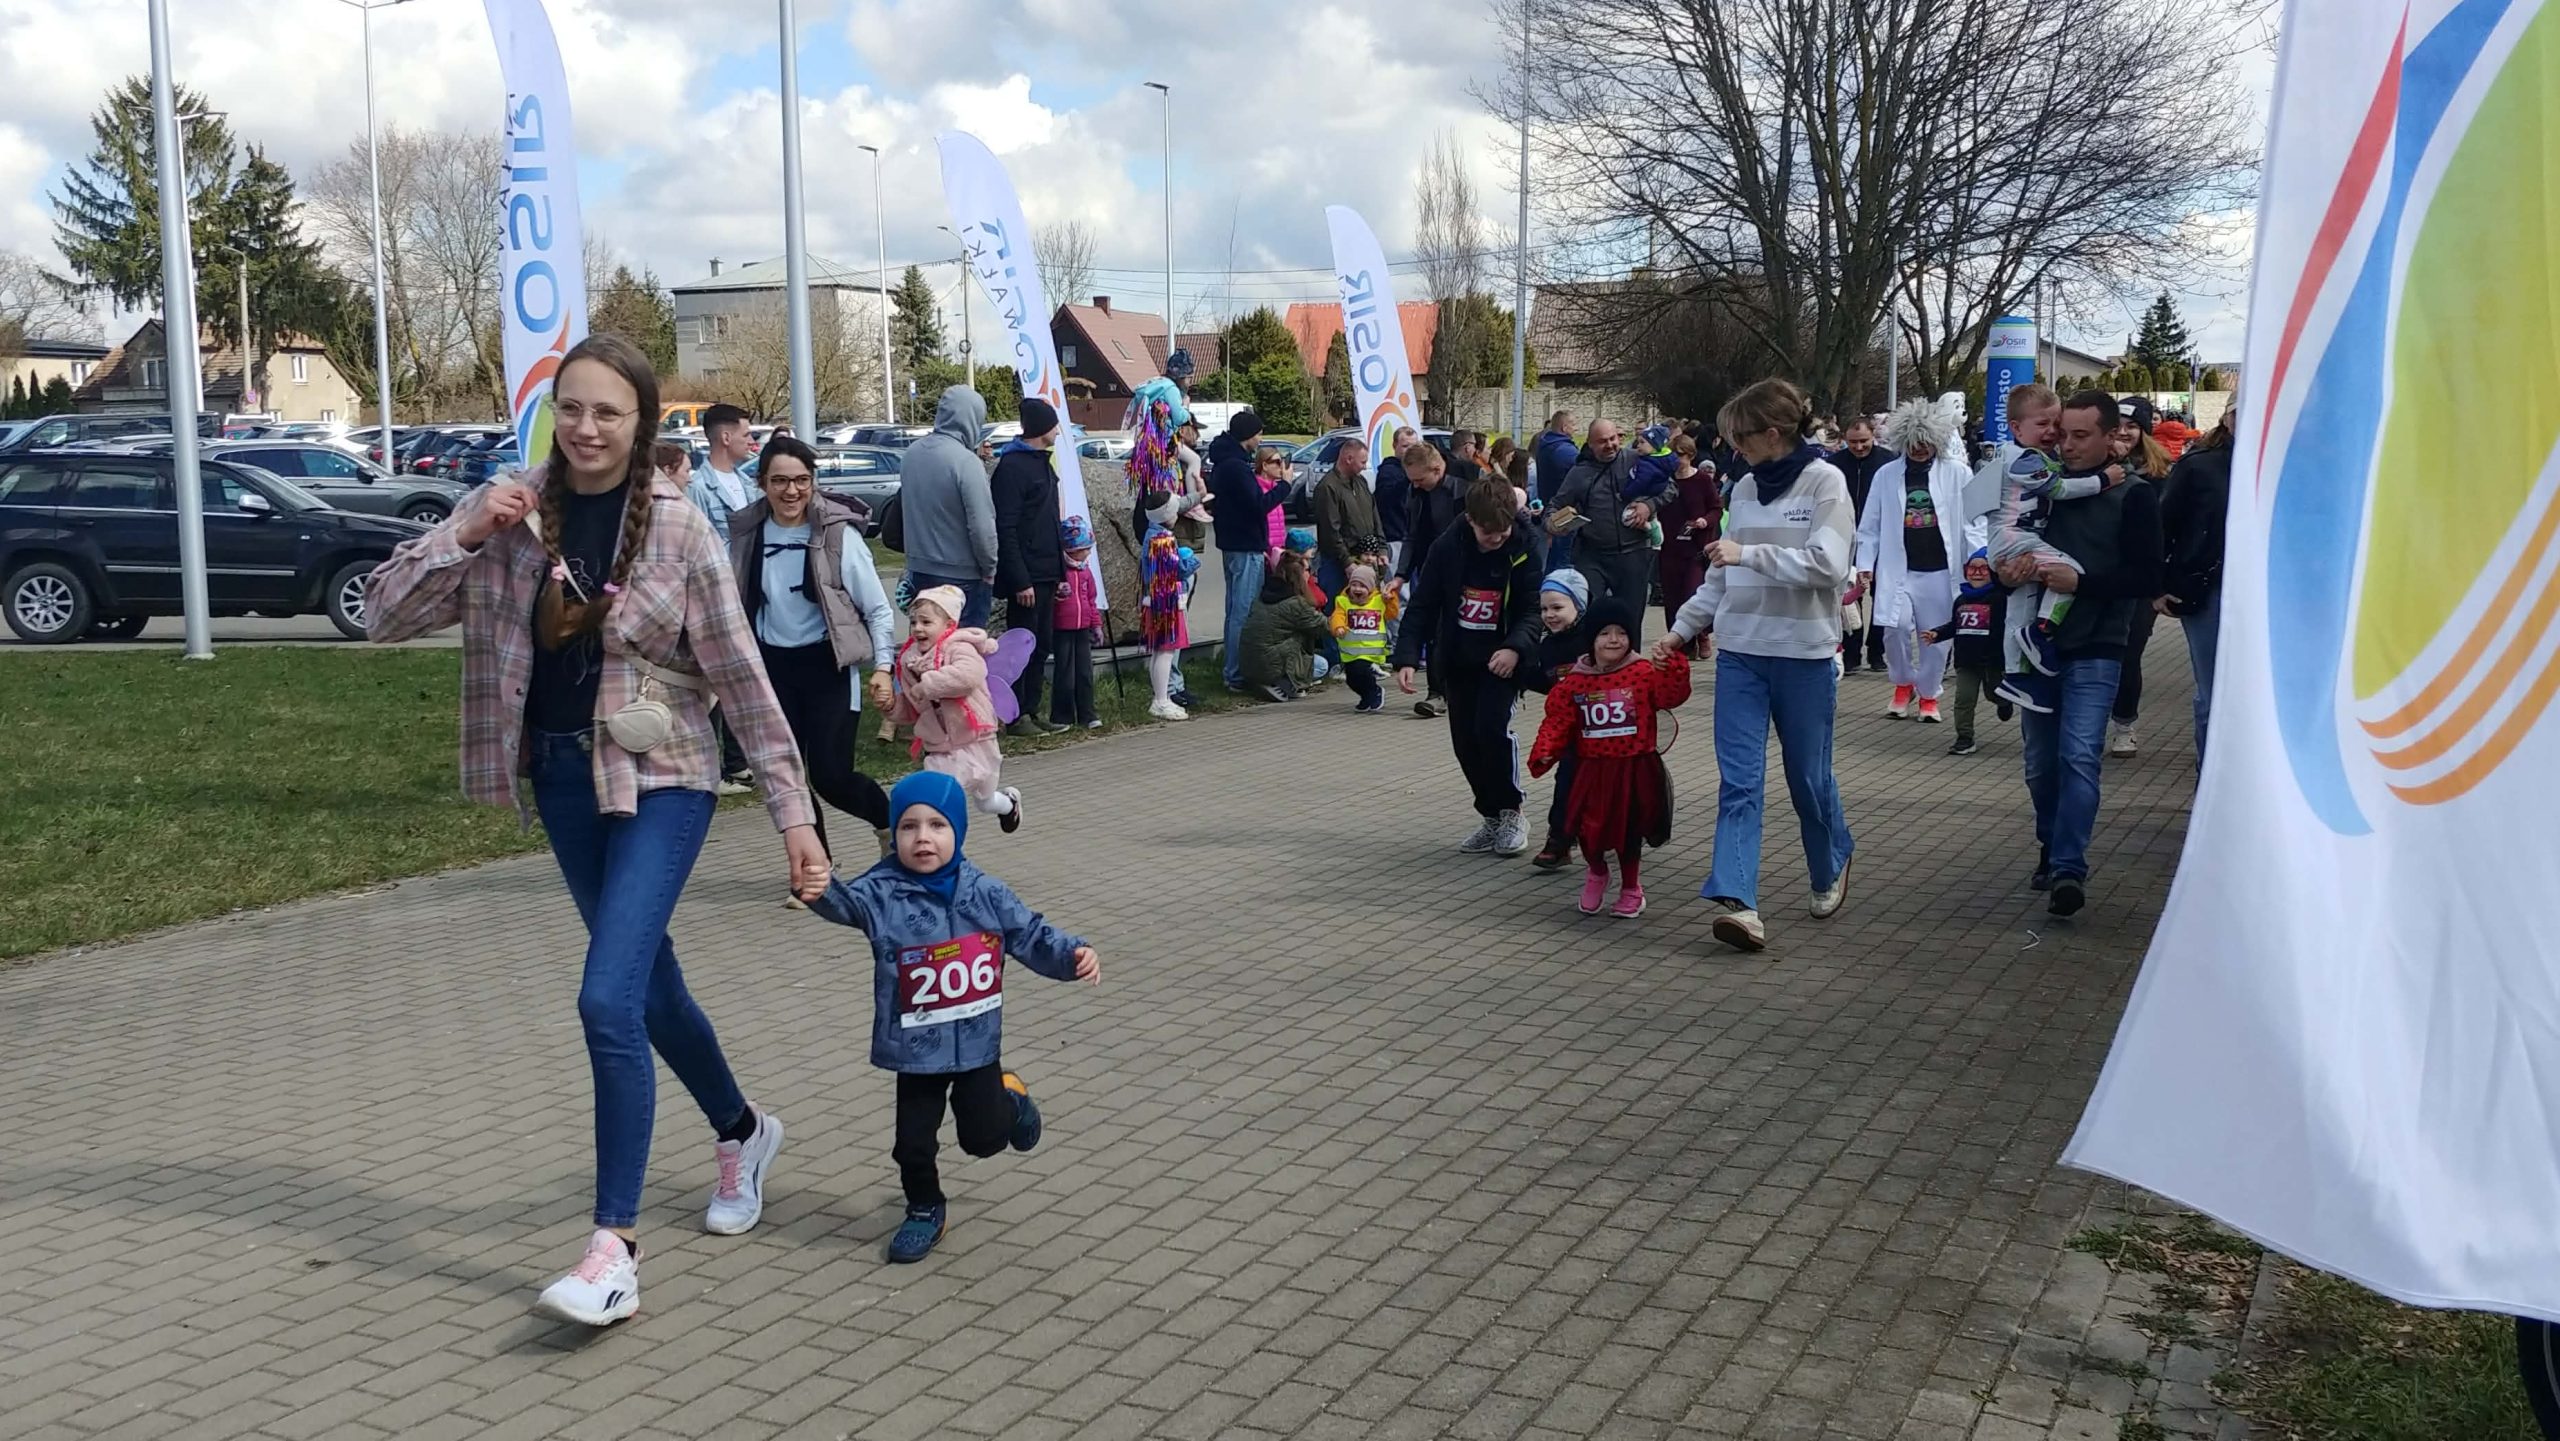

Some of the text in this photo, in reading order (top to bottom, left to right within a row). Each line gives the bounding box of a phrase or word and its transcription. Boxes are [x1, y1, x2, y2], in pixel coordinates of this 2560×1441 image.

[1352, 615, 1376, 628] 146
[1960, 612, 1979, 626] 73
[1580, 701, 1627, 726] 103
[909, 952, 995, 1005] 206
